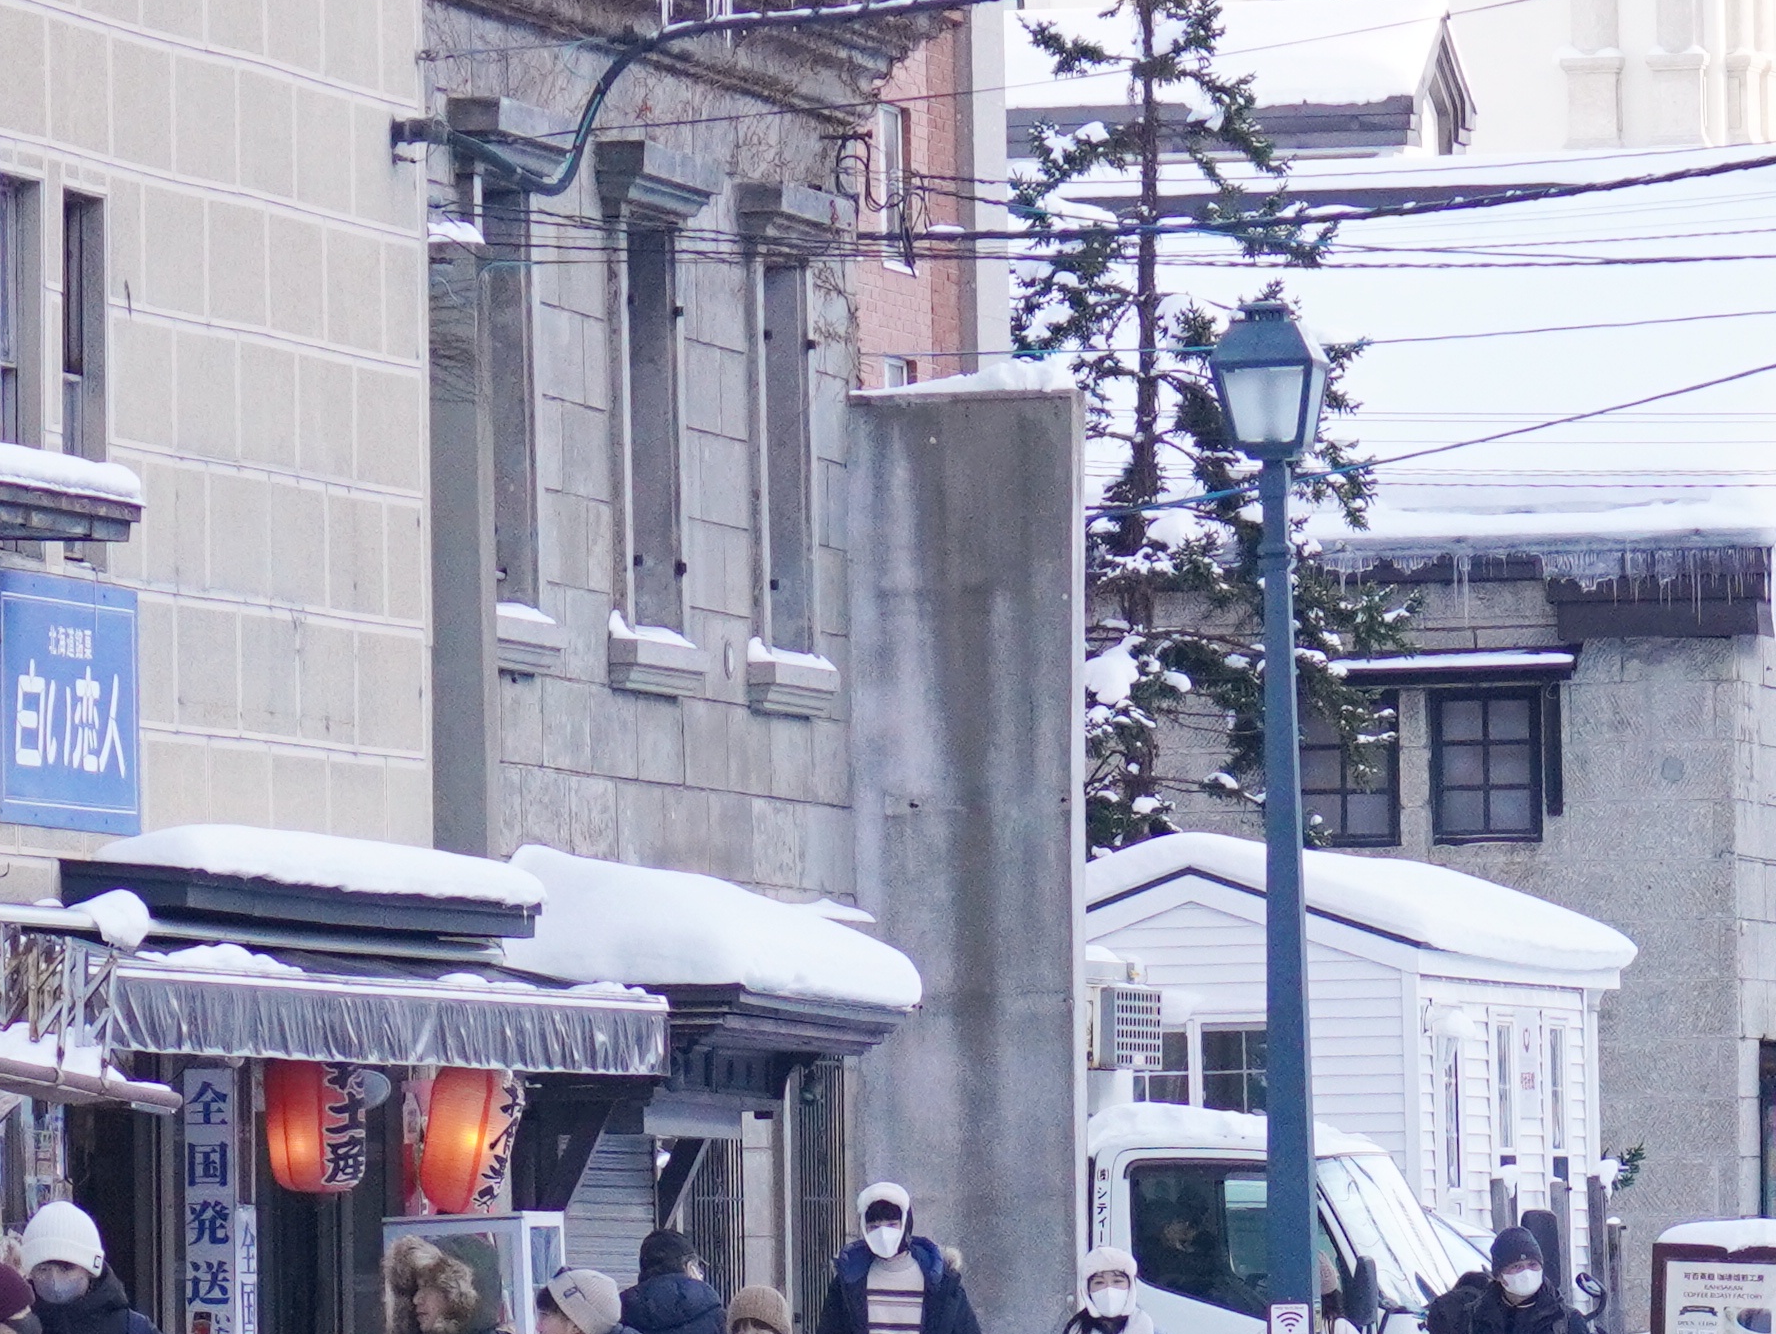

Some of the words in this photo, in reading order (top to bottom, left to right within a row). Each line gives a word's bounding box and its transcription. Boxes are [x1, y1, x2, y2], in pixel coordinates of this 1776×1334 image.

[48, 624, 93, 659] 北海道銘菓
[15, 658, 126, 779] 白い恋人
[186, 1081, 230, 1307] 全国発送
